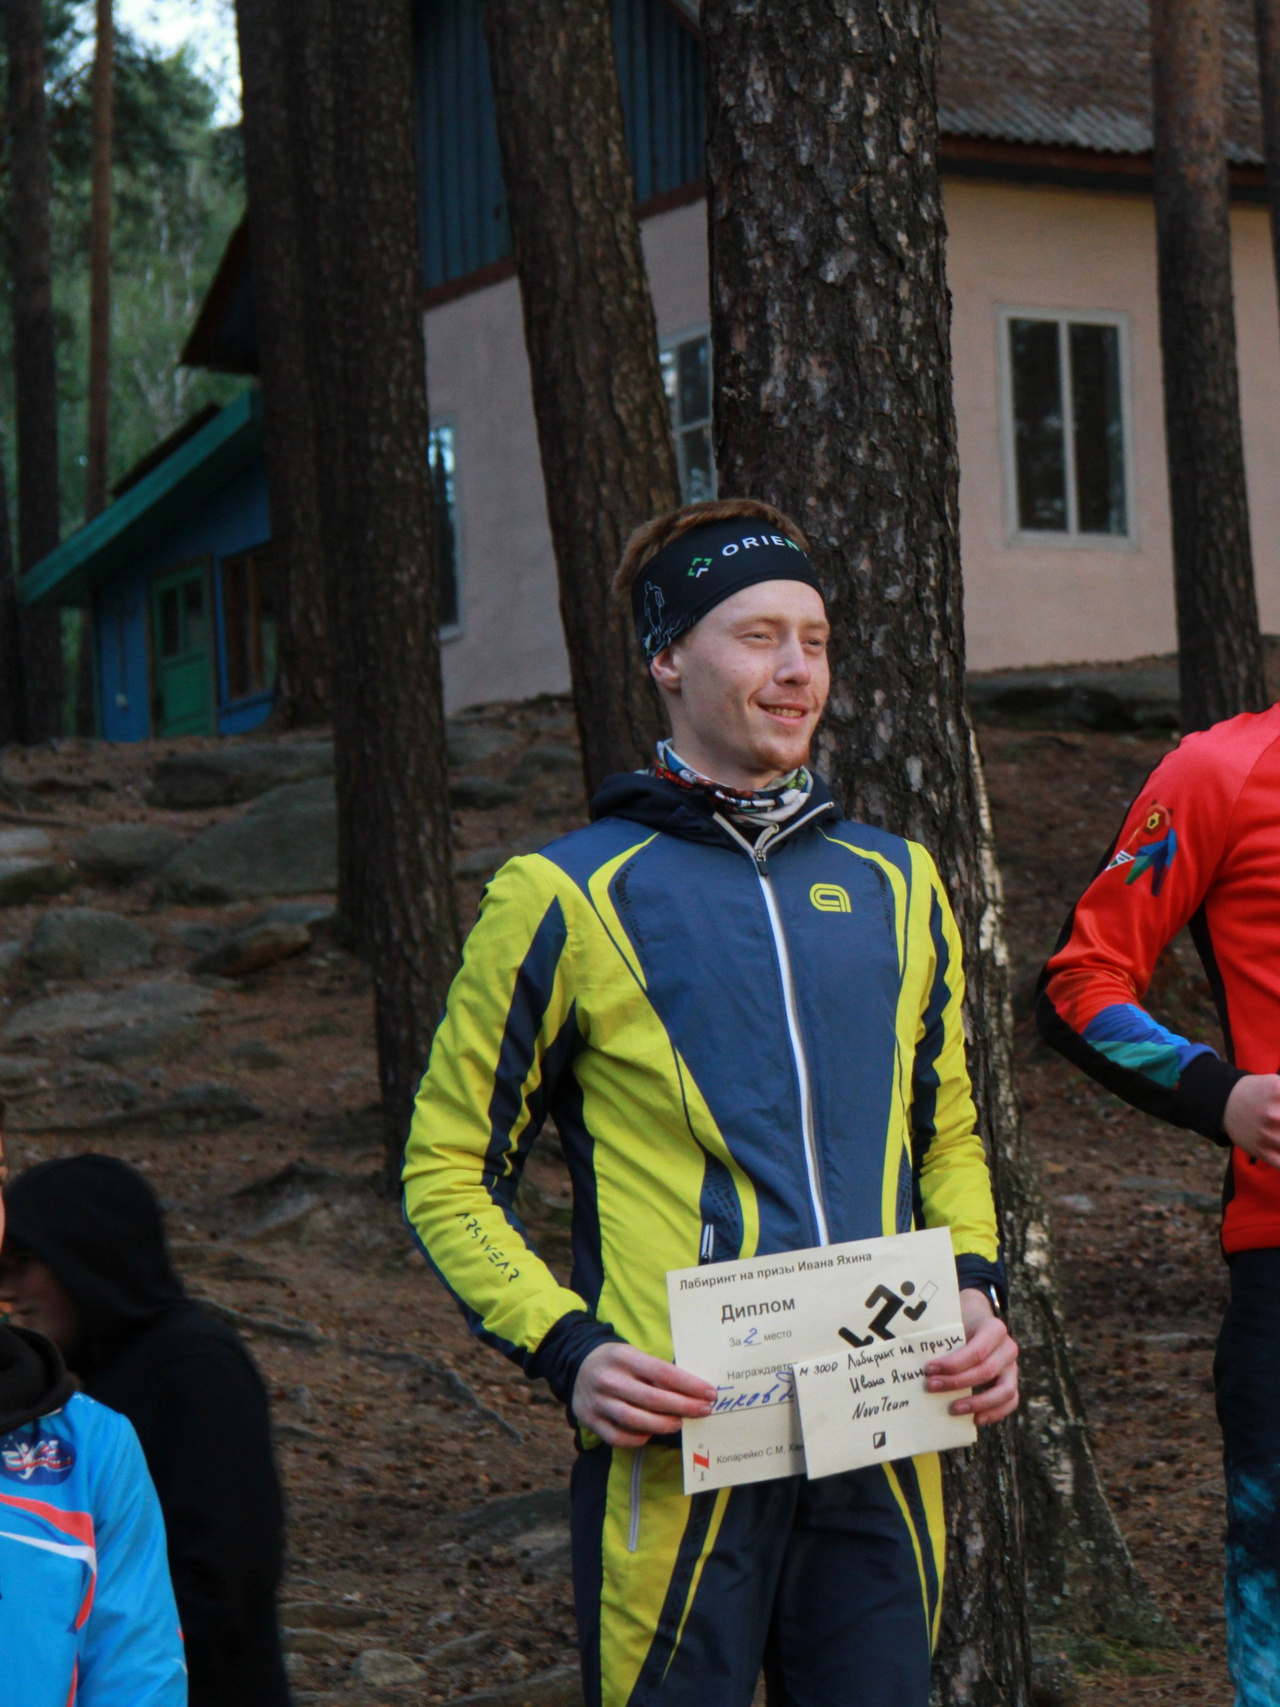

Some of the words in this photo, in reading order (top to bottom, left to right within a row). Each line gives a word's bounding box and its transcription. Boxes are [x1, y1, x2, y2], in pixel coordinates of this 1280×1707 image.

[679, 1273, 737, 1291] Лабиринт
[740, 1270, 754, 1281] на
[757, 1264, 795, 1280] призы
[798, 1258, 834, 1272] Ивана
[837, 1251, 872, 1267] Яхина
[720, 1298, 796, 1324] Диплом
[729, 1336, 742, 1348] За
[743, 1328, 758, 1346] 2
[764, 1329, 792, 1342] место
[727, 1361, 799, 1382] Награждаетс
[813, 1362, 839, 1375] 3000
[848, 1347, 895, 1370] Лабиринт
[849, 1375, 886, 1394] Ивана
[892, 1368, 928, 1385] Яхин
[716, 1449, 763, 1465] Копарейко
